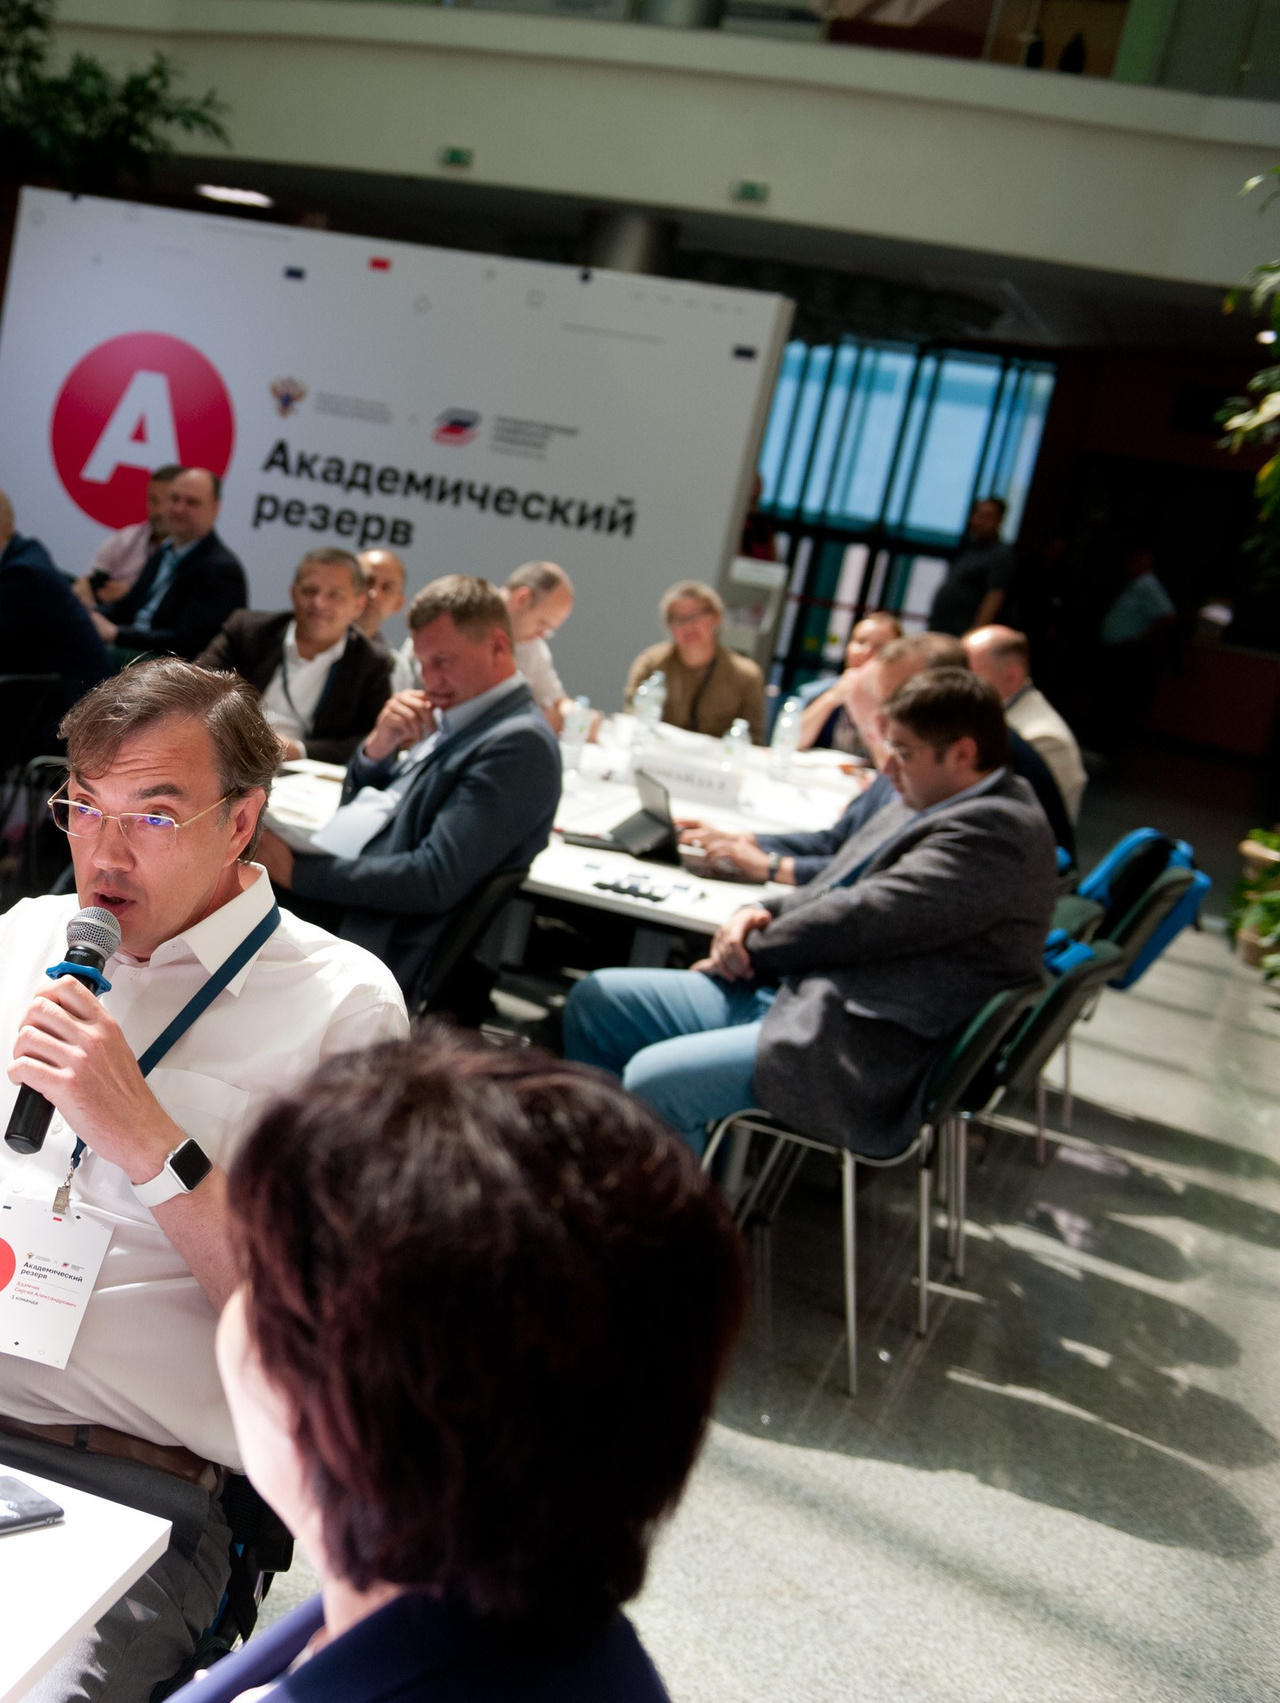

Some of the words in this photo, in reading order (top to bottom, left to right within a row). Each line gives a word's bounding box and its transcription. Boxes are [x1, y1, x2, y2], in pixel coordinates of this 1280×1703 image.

[262, 438, 637, 539] Академический
[252, 492, 415, 549] резерв
[20, 1269, 48, 1280] резерв
[23, 1261, 83, 1283] Академический
[14, 1287, 34, 1295] Сергей
[34, 1292, 77, 1308] Александрович
